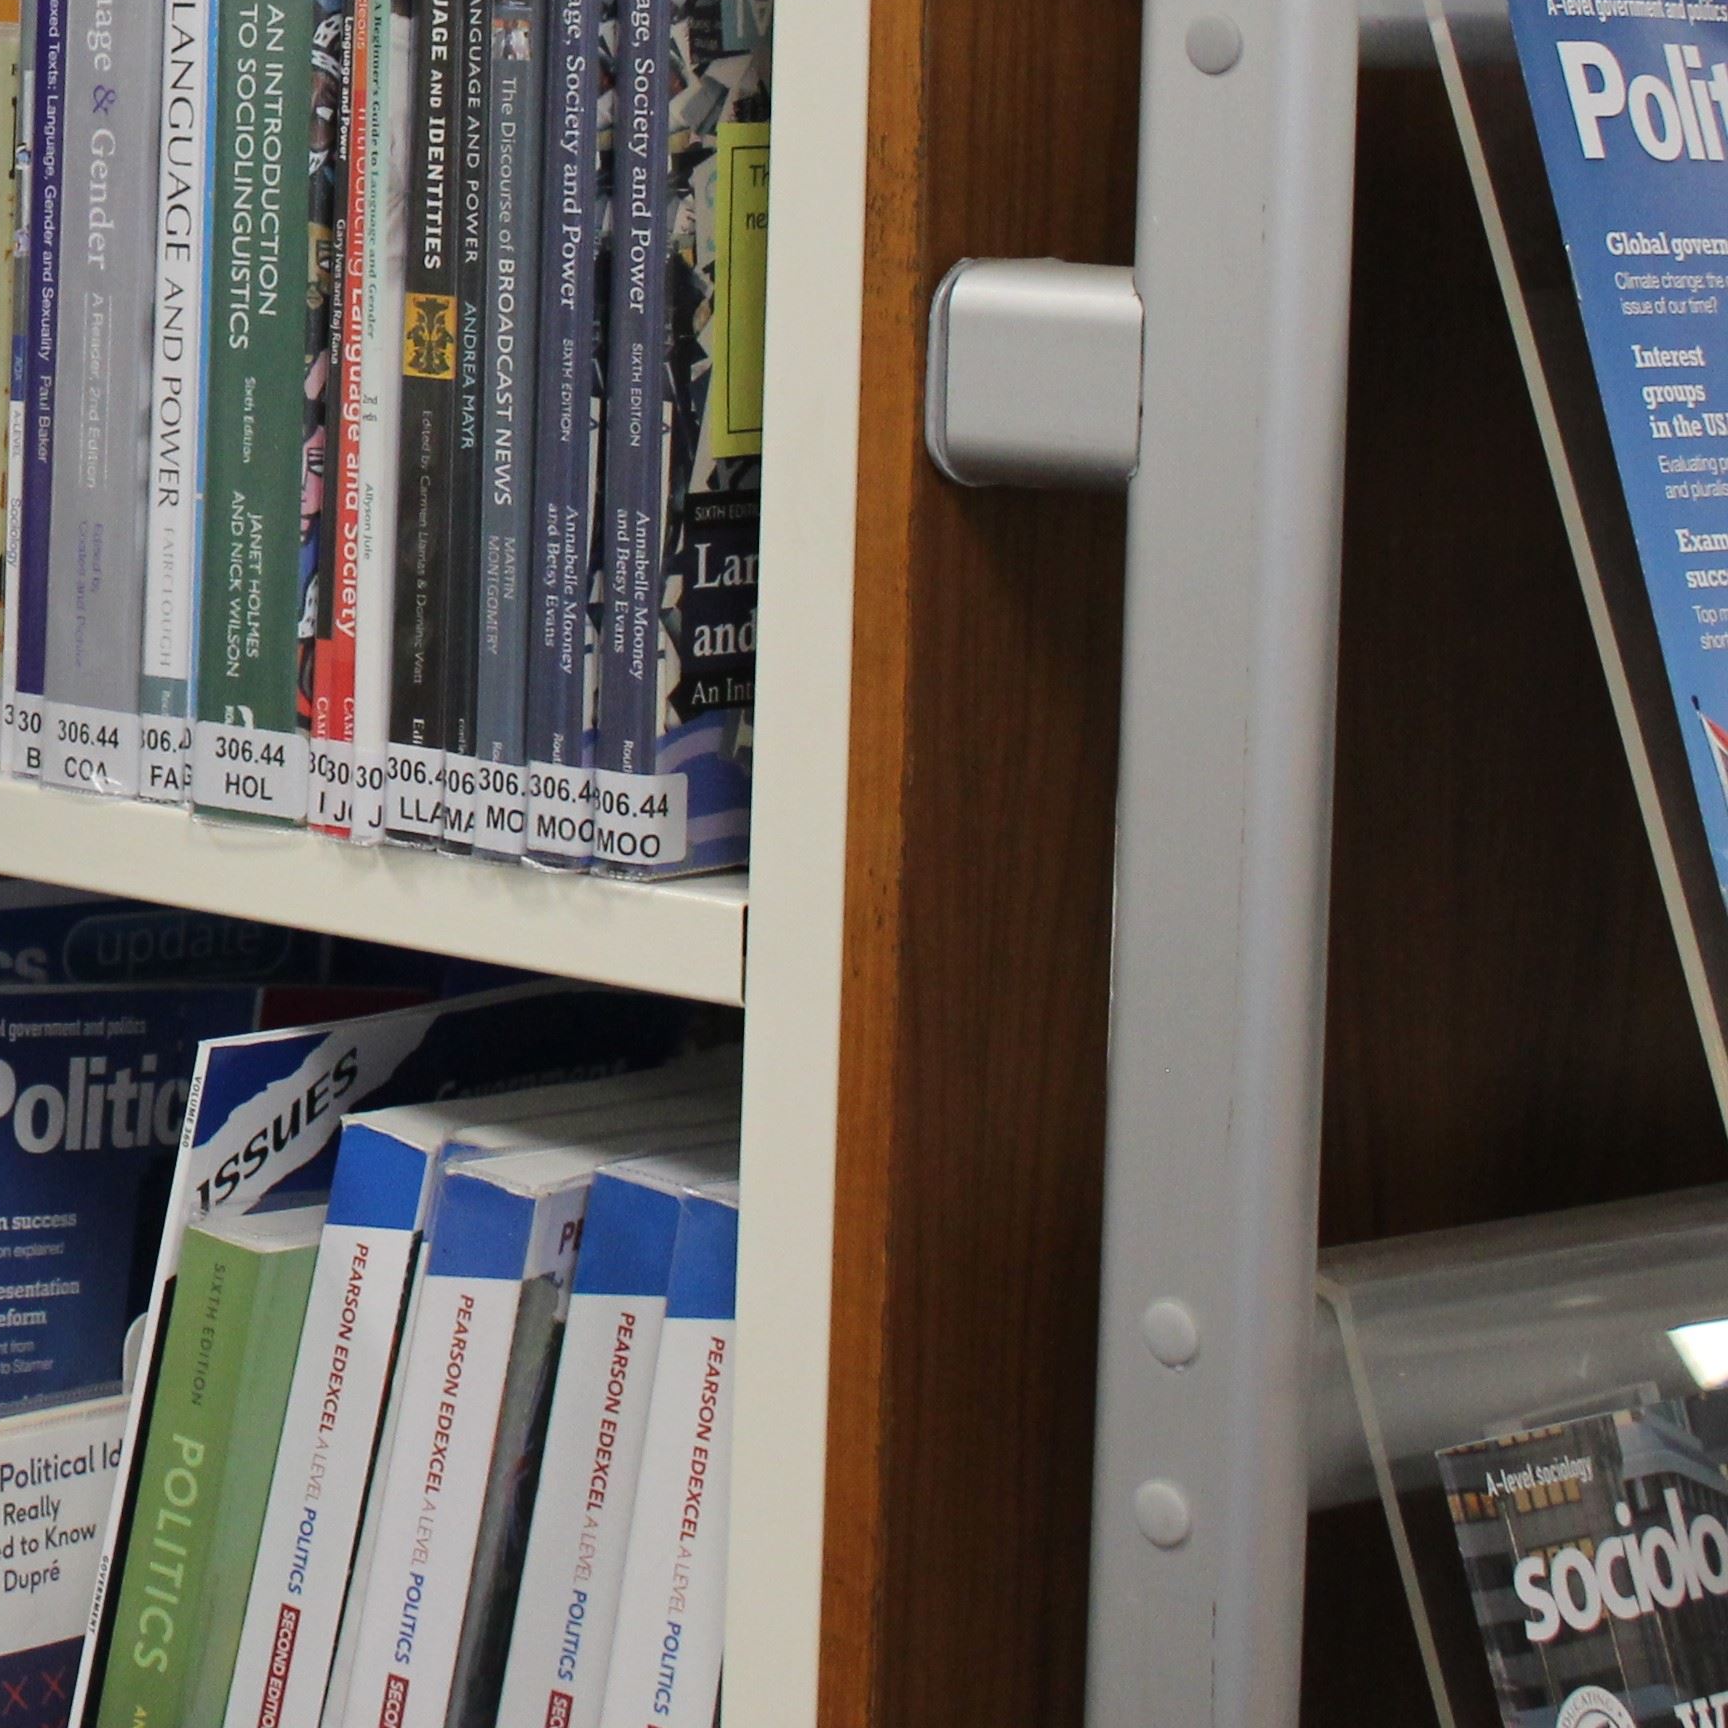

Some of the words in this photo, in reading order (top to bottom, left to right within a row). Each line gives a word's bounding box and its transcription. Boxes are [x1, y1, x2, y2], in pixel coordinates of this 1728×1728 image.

[238, 3, 258, 49] TO
[265, 3, 285, 52] AN
[92, 85, 118, 115] &
[162, 1, 197, 263] LANGUAGE
[430, 70, 444, 110] AND
[559, 55, 586, 150] Society
[256, 59, 283, 316] INTRODUCTION
[466, 118, 480, 172] AND
[561, 156, 581, 220] and
[86, 128, 117, 270] Gender
[229, 58, 258, 350] SOCIOLINGUISTICS
[422, 118, 446, 270] IDENTITIES
[463, 178, 480, 265] POWER
[559, 224, 585, 311] Power
[1606, 231, 1671, 256] Global
[161, 278, 185, 362] AND
[1631, 344, 1705, 369] Interest
[1643, 384, 1706, 407] groups
[157, 377, 182, 509] POWER
[231, 491, 245, 540] AND
[1665, 481, 1690, 500] and
[229, 545, 243, 589] NICK
[249, 512, 263, 564] JANET
[225, 595, 242, 678] WILSON
[246, 571, 262, 659] HOLMES
[57, 720, 120, 749] 306.44
[214, 736, 286, 768] 306.44
[224, 773, 274, 803] HOL
[194, 1044, 362, 1215] ISSUES
[12, 1211, 77, 1230] success
[339, 1243, 370, 1342] PEARSON
[440, 1293, 476, 1394] PEARSON
[604, 1310, 636, 1416] PEARSON
[316, 1341, 350, 1435] EDEXCEL
[696, 1335, 727, 1440] PEARSON
[424, 1397, 457, 1496] EDEXCEL
[589, 1416, 619, 1512] EDEXCEL
[1486, 1462, 1536, 1498] A-level
[1537, 1454, 1594, 1488] sociology
[3, 1496, 61, 1527] Really
[679, 1440, 710, 1543] EDEXCEL
[3, 1560, 61, 1595] Dupré
[21, 1534, 40, 1555] to
[45, 1522, 97, 1549] Know
[132, 1432, 206, 1673] POLITICS
[285, 1505, 317, 1596] POLITICS
[392, 1570, 425, 1665] POLITICS
[556, 1589, 587, 1683] POLITICS
[652, 1620, 683, 1716] POLITICS
